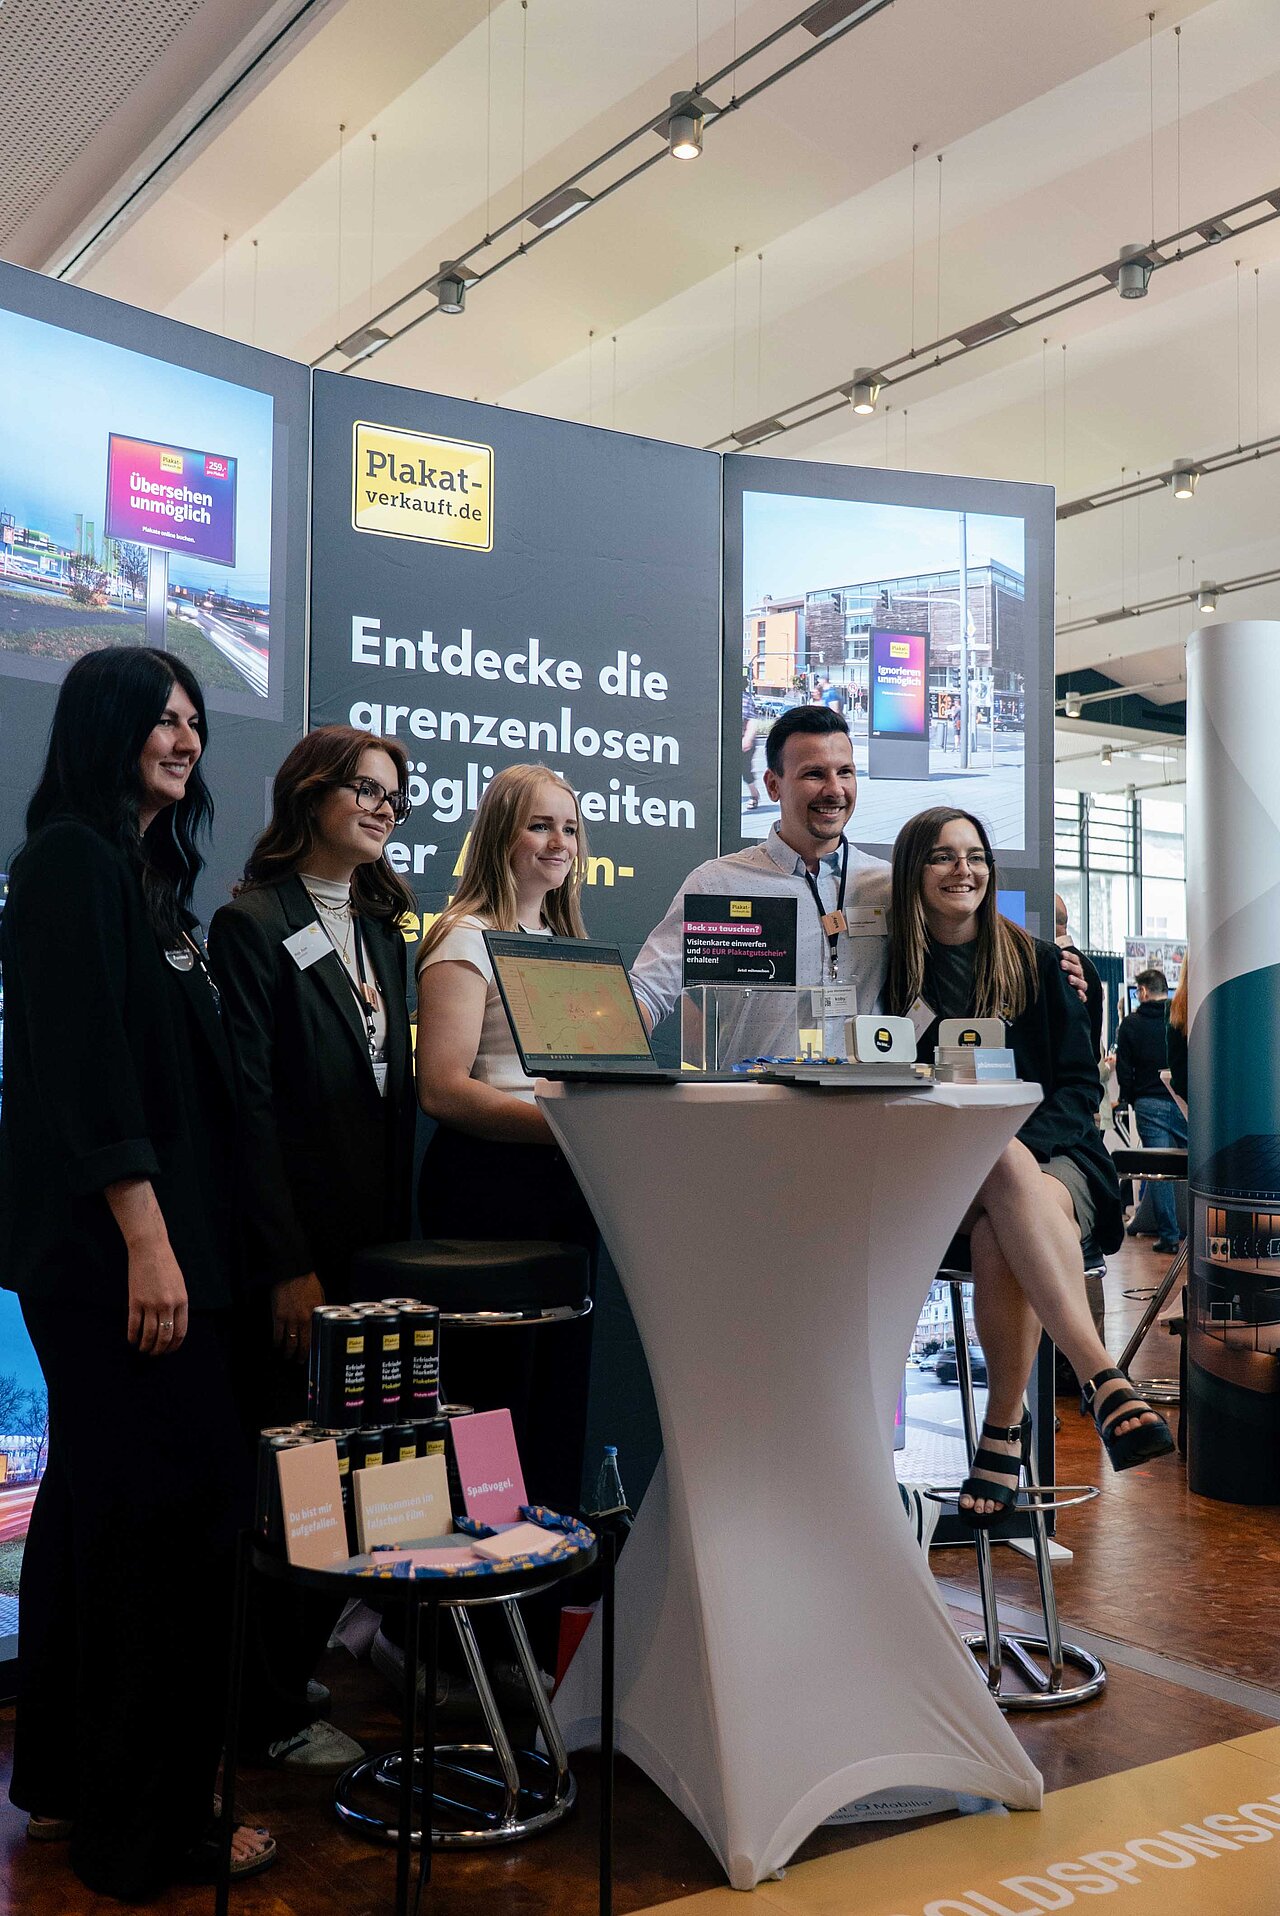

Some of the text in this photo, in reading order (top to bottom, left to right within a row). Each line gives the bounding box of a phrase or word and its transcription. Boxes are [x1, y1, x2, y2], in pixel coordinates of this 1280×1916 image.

[366, 449, 482, 494] Plakat-
[130, 472, 212, 507] Übersehen
[130, 495, 211, 524] unmöglich
[366, 489, 482, 522] verkauft.de
[352, 615, 668, 701] Entdecke die
[878, 665, 921, 676] Ignorieren
[878, 676, 921, 687] unmöglich
[349, 700, 680, 765] grenzenlosen
[385, 841, 438, 874] er
[687, 924, 706, 932] Bock
[720, 925, 759, 933] tauschen?
[687, 939, 766, 948] Visitenkarte einwerfen
[686, 956, 719, 964] erhalten!
[467, 1478, 514, 1498] Spaßvogel.
[289, 1502, 332, 1522] Du bist mir
[366, 1493, 434, 1515] Willkommen im
[291, 1517, 338, 1537] aufgefallen.
[897, 1795, 1280, 1916] OLDSPONSO
